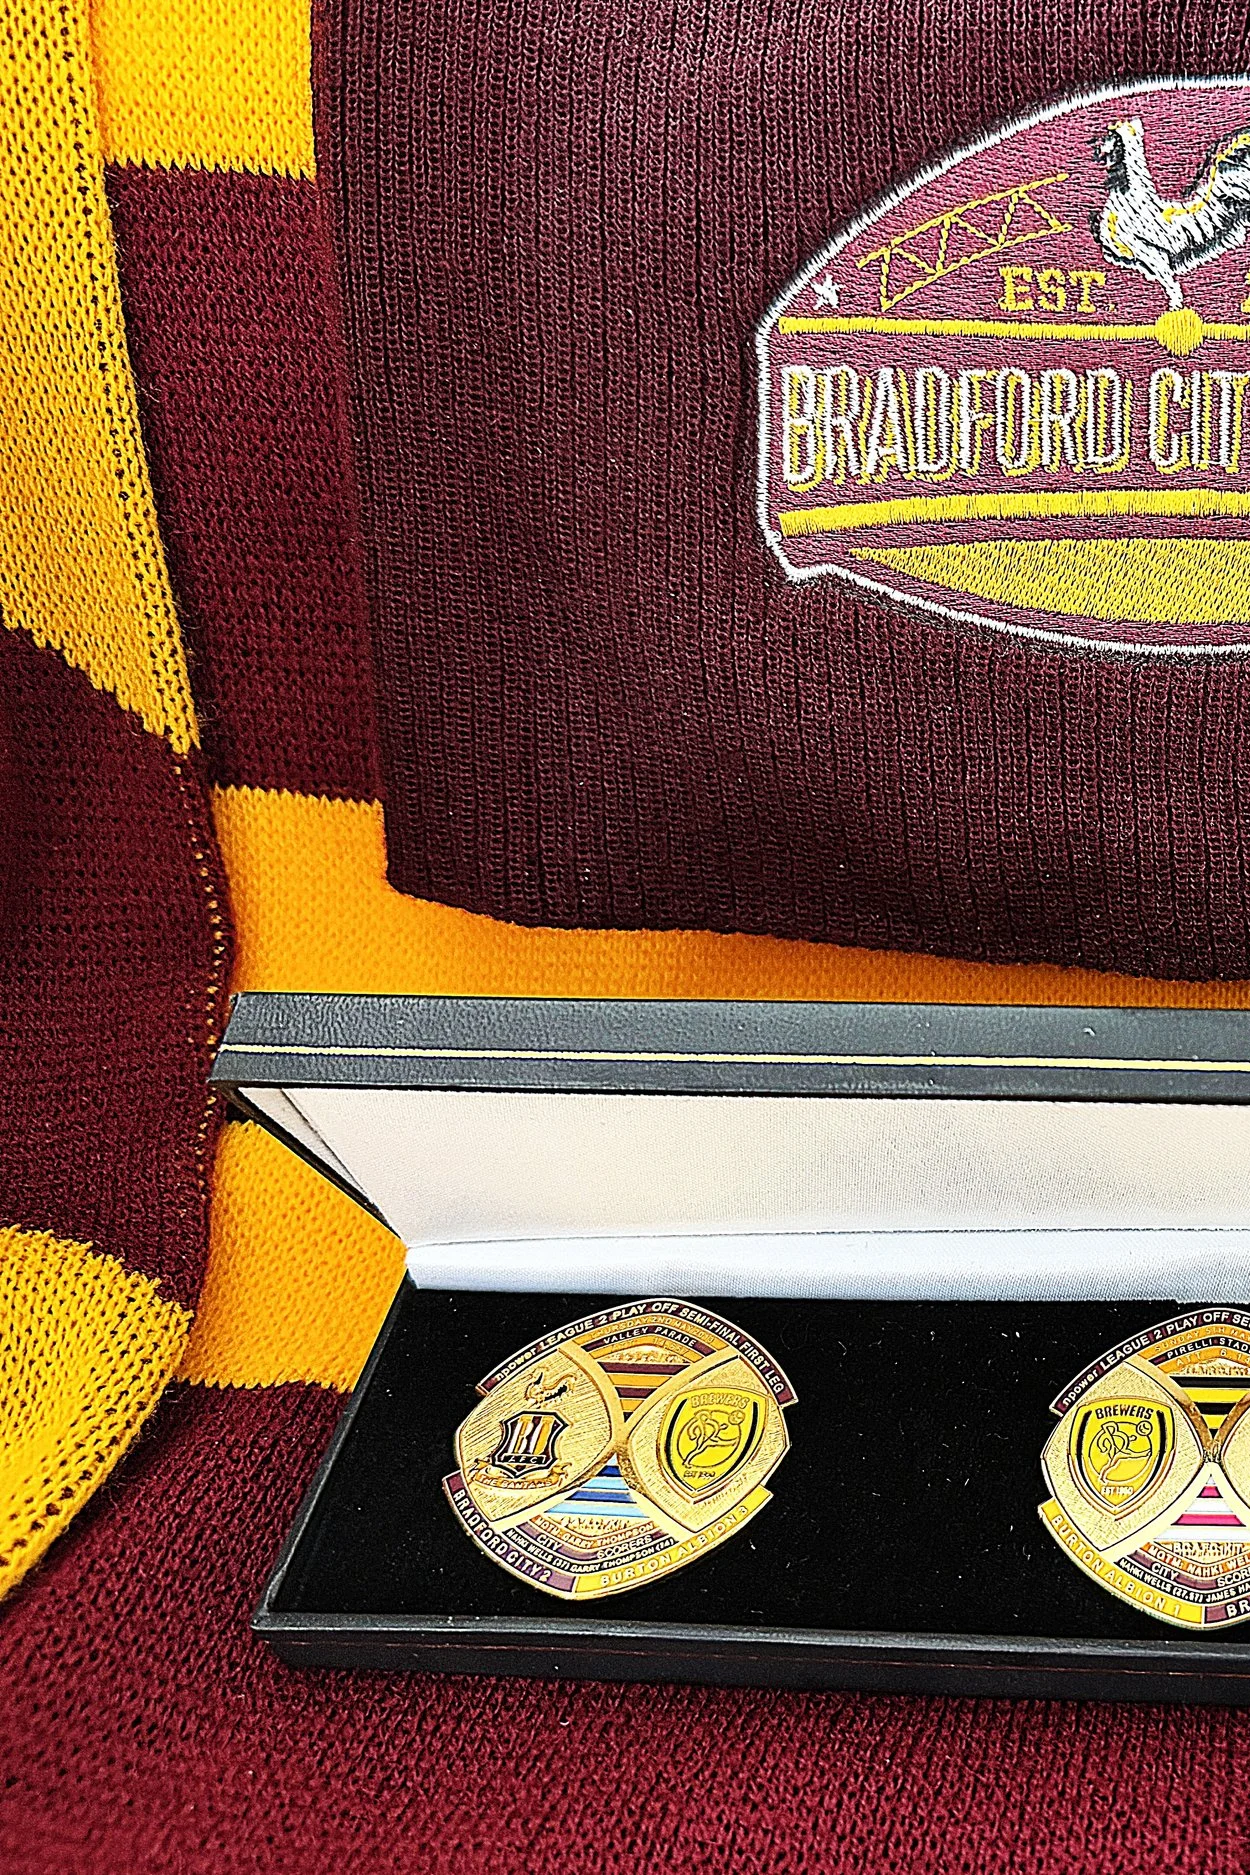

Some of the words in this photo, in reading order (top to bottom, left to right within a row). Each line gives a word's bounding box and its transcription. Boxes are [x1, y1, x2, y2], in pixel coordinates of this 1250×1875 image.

[999, 267, 1117, 313] EST.
[781, 367, 1132, 492] BRADFORD
[495, 1349, 538, 1382] npower
[540, 1319, 594, 1348] LEAGUE
[599, 1315, 608, 1325] 2
[611, 1304, 646, 1321] PLAY
[652, 1302, 680, 1313] OFF
[680, 1306, 741, 1346] SEMI-FINAL
[739, 1341, 770, 1370] FIRST
[765, 1369, 785, 1393] LEG
[604, 1327, 648, 1344] VALLEY
[654, 1326, 697, 1347] PARADE
[1167, 1339, 1213, 1359] PIRELLI
[1062, 1368, 1099, 1406] npower
[1100, 1335, 1150, 1370] LEAGUE
[1154, 1329, 1164, 1340] 2
[1166, 1315, 1199, 1336] PLAY
[1202, 1312, 1230, 1323] OFF
[691, 1393, 750, 1409] BREWERS
[1095, 1404, 1155, 1419] BREWERS
[453, 1489, 509, 1556] BRADFORD
[506, 1553, 543, 1577] CITY
[540, 1569, 553, 1582] 2
[537, 1534, 562, 1551] CITY
[596, 1534, 653, 1559] SCORERS
[601, 1553, 672, 1586] BURTON
[677, 1515, 738, 1558] ALBION
[1052, 1515, 1104, 1573] BURTON
[1107, 1569, 1167, 1610] ALBION
[1174, 1605, 1181, 1617] 1
[1151, 1562, 1179, 1581] CITY
[1186, 1565, 1223, 1577] NAHKI
[1206, 1588, 1236, 1602] JAMES
